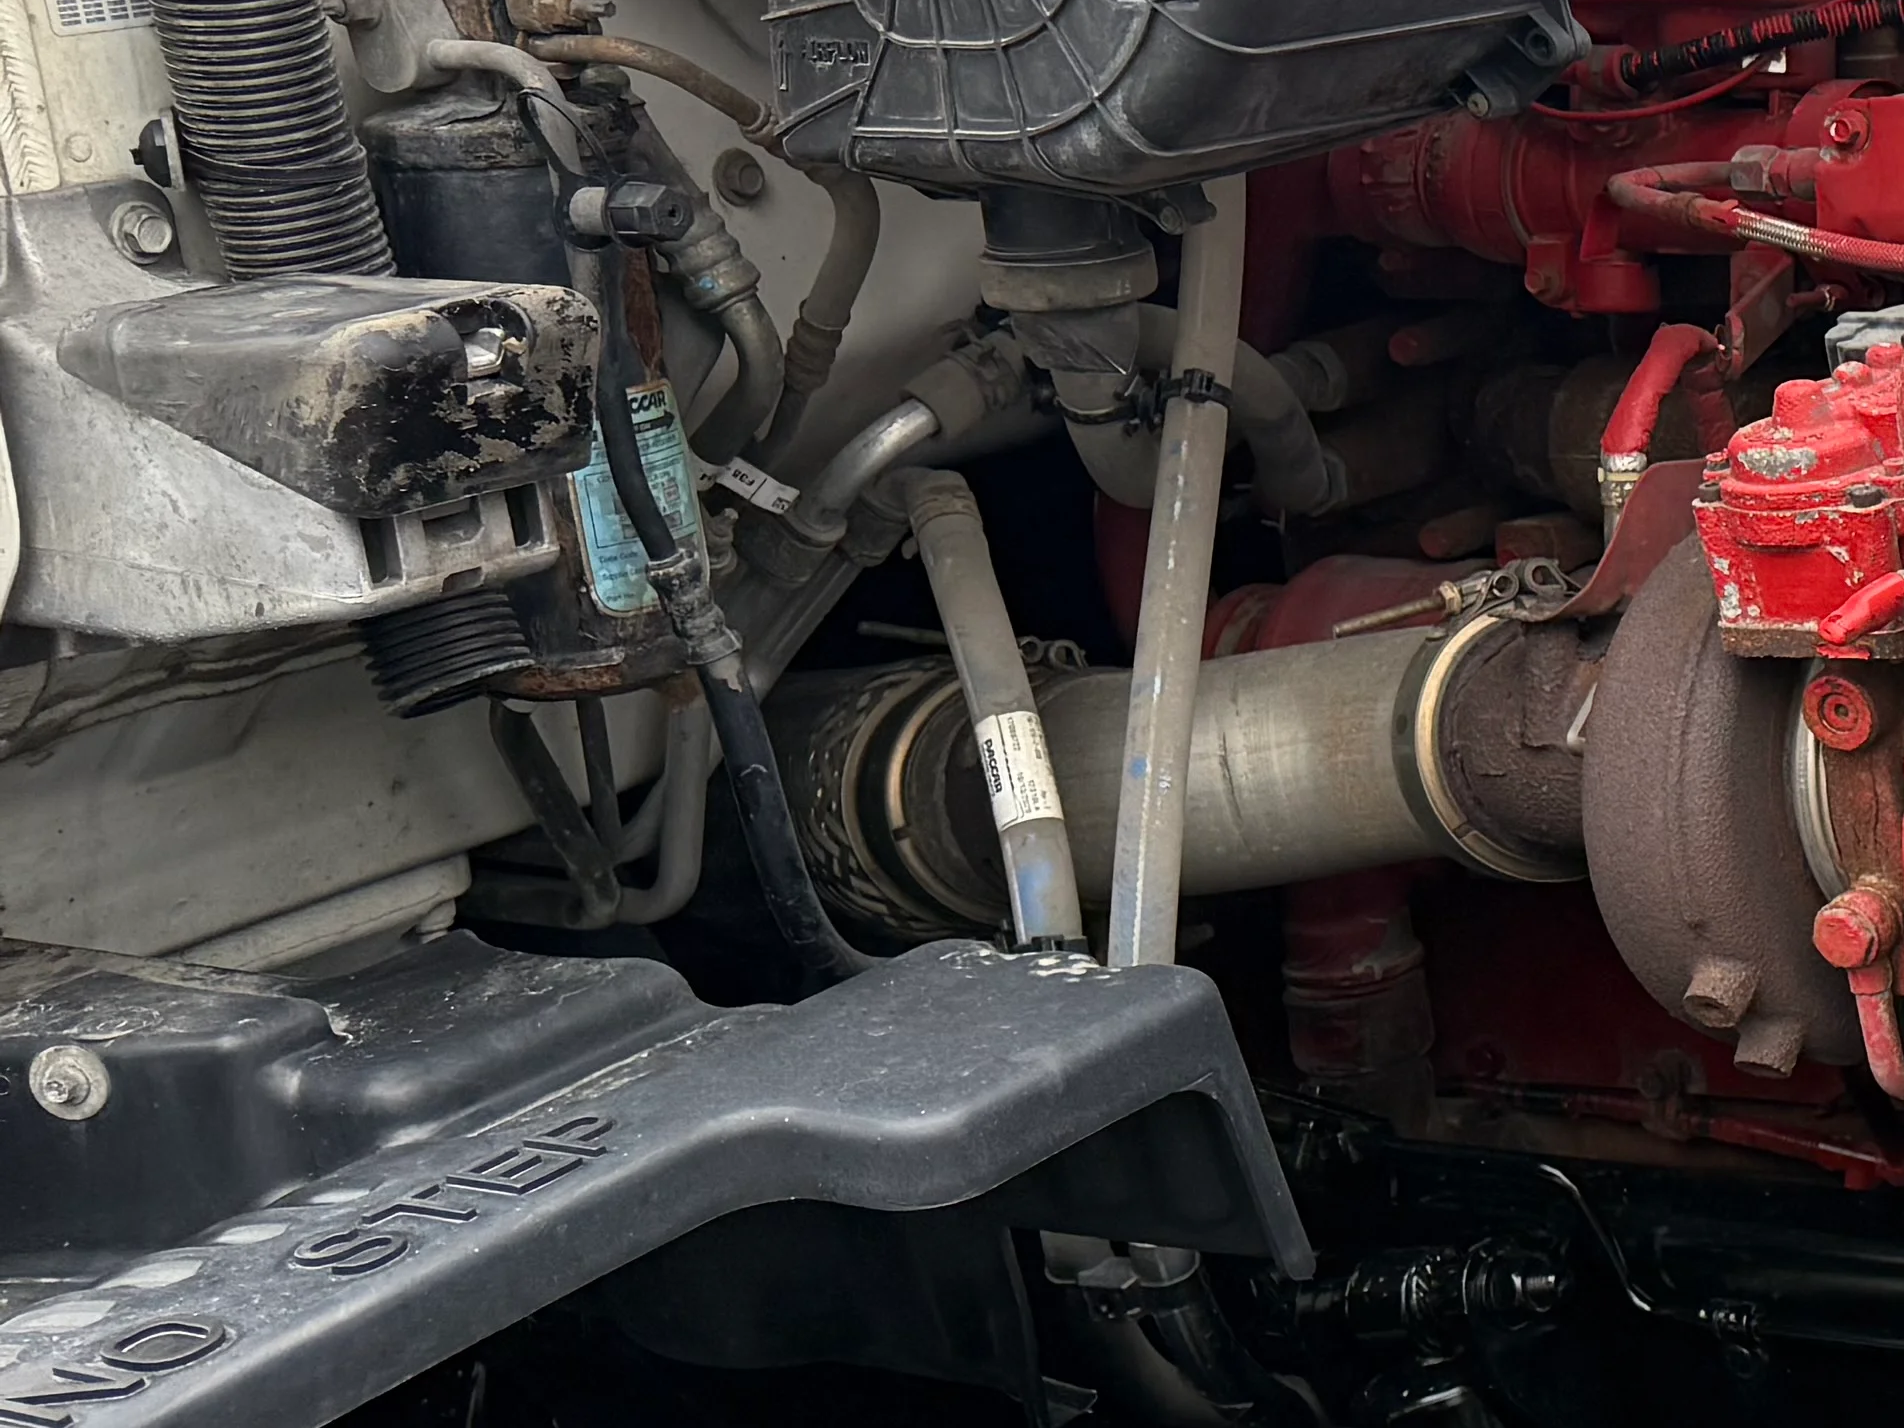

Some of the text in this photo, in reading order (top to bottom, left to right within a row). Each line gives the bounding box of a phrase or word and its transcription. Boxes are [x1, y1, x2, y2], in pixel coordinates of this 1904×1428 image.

[629, 390, 667, 414] CCAR
[984, 738, 1002, 793] PACCAR
[291, 1114, 619, 1278] STEP
